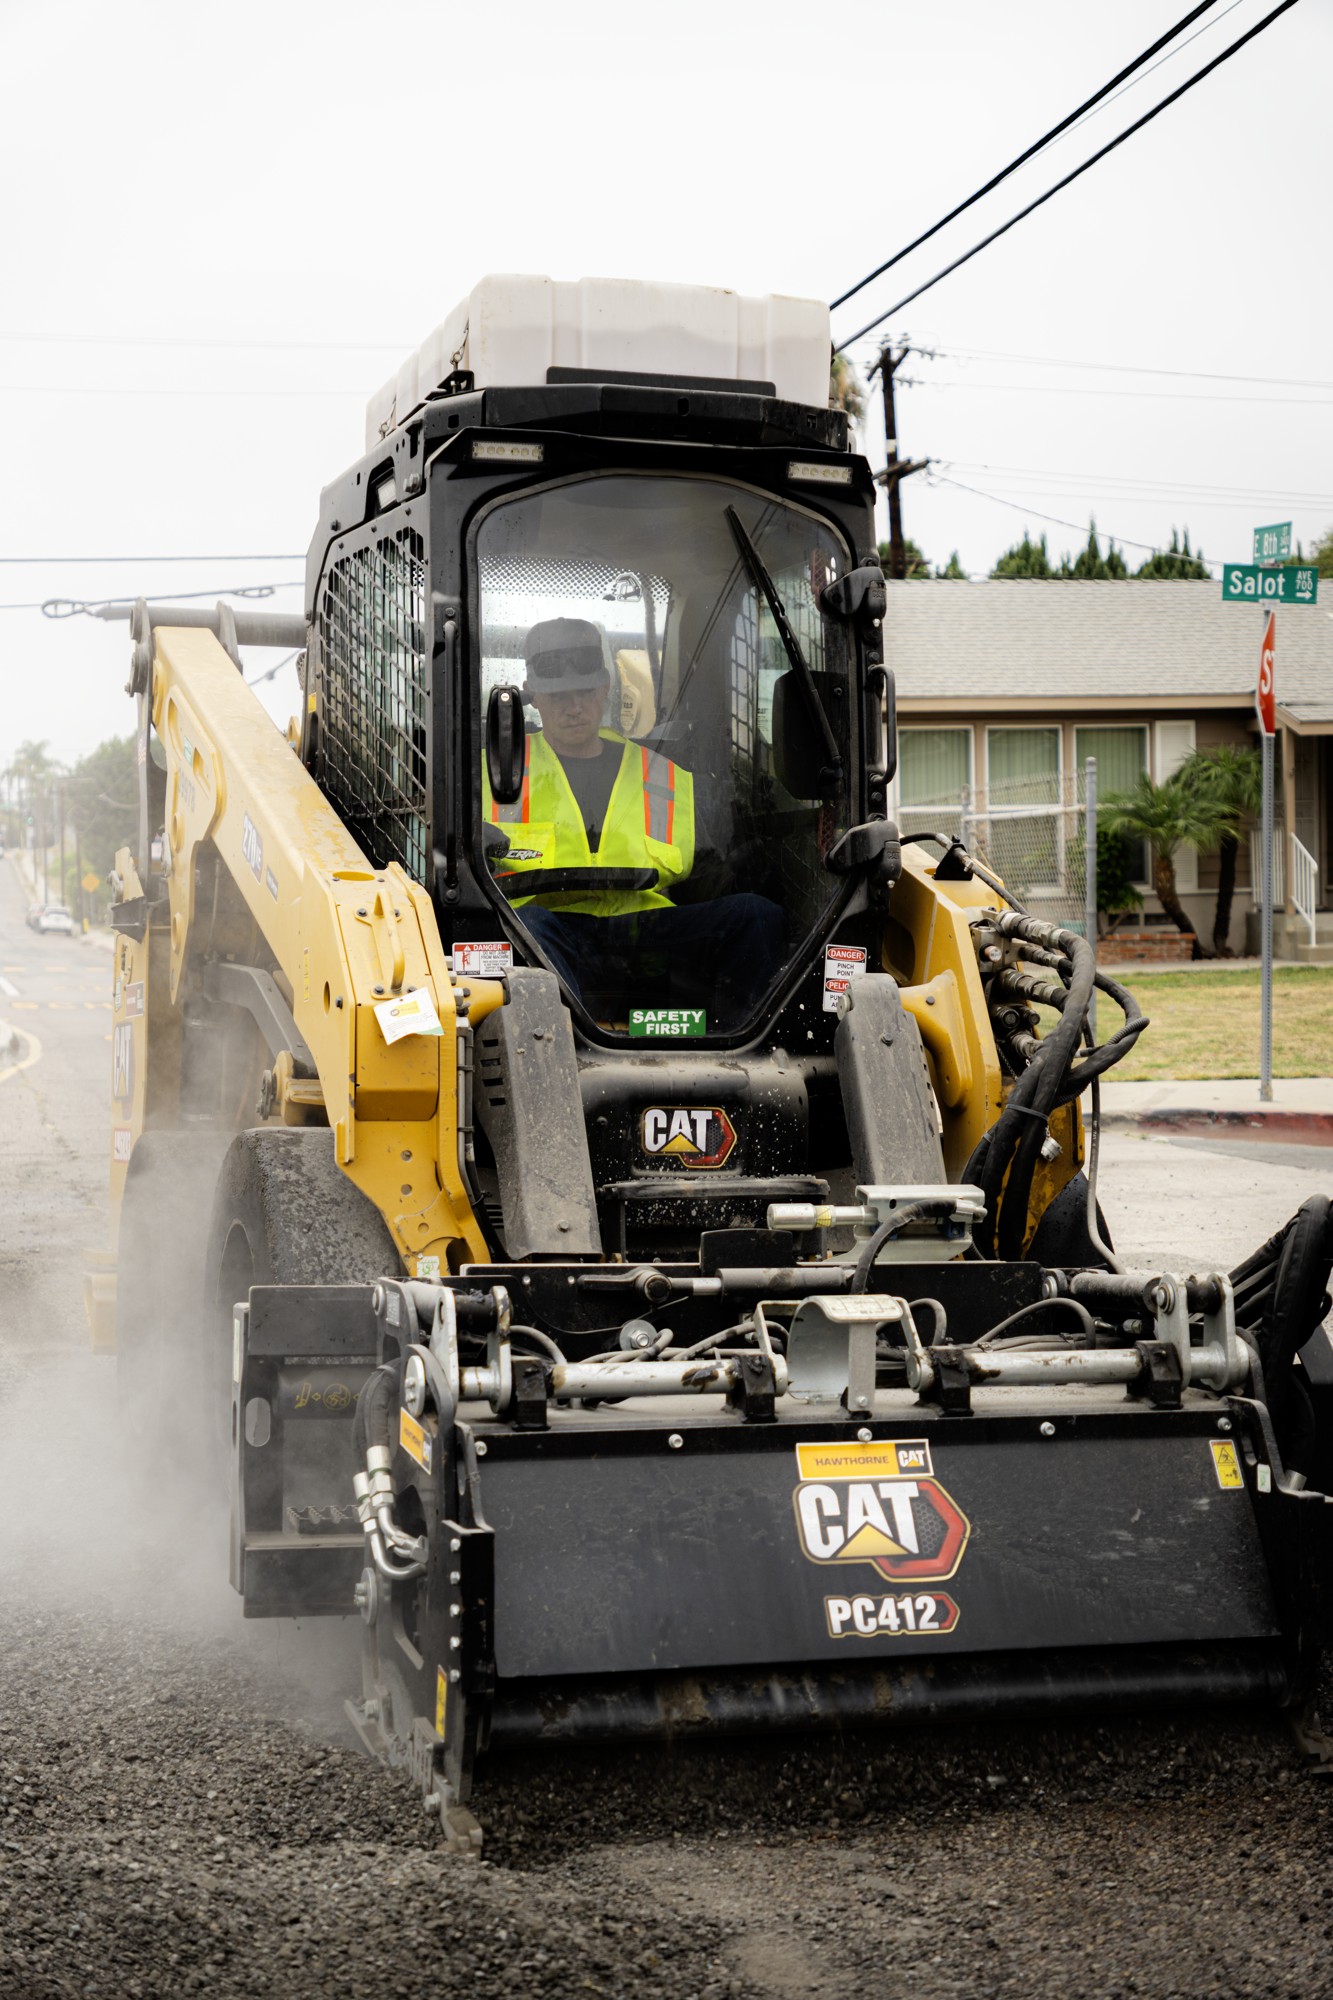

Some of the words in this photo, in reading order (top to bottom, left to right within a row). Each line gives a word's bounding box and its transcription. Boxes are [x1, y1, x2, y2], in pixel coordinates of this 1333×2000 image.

[1263, 532, 1278, 556] 8th
[1229, 570, 1286, 596] Salot
[1297, 570, 1313, 580] AVE
[1296, 580, 1313, 591] 700
[830, 949, 862, 960] DANGER
[632, 1010, 703, 1024] SAFETY
[646, 1023, 690, 1035] FIRST
[644, 1108, 713, 1153] CAT
[815, 1455, 889, 1467] HAWTHORNE
[898, 1450, 924, 1467] CAT
[798, 1481, 920, 1558] CAT
[827, 1595, 940, 1634] PC412
